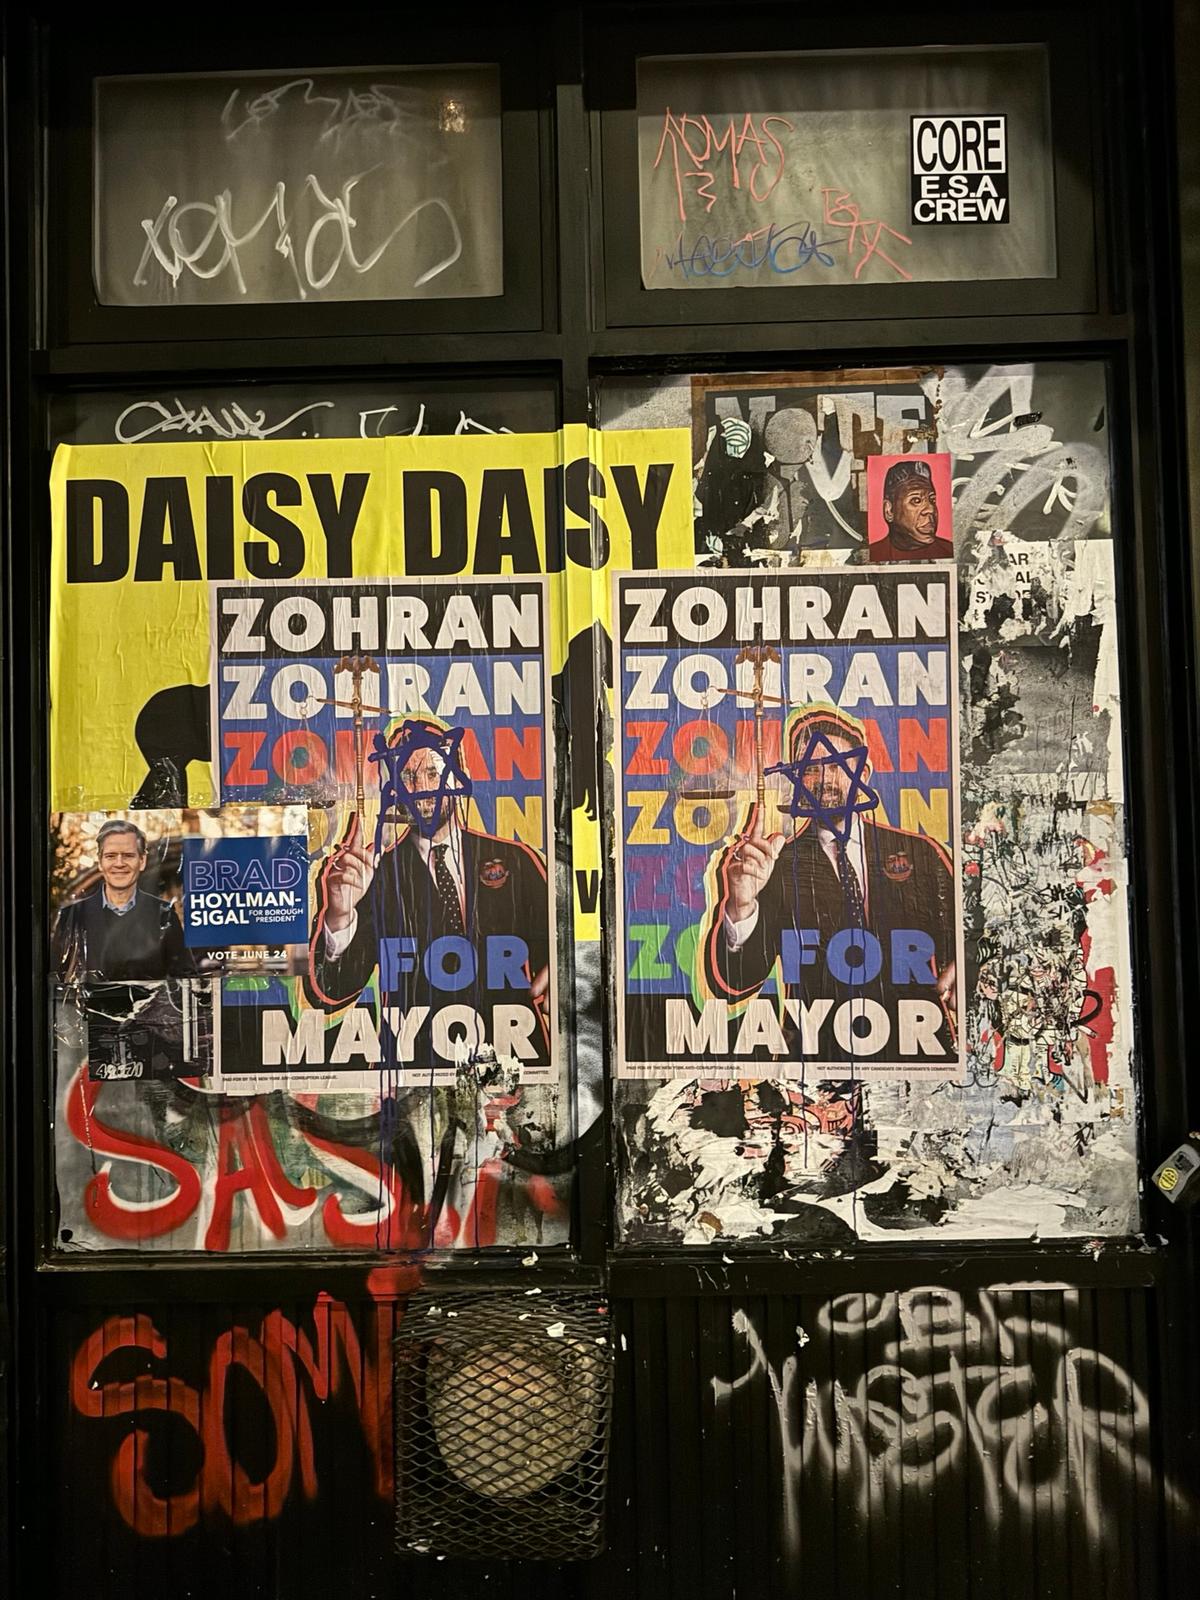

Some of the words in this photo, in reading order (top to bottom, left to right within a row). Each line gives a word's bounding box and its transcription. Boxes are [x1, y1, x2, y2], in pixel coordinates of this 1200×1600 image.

[917, 120, 1002, 172] CORE
[914, 198, 1006, 222] CREW
[921, 175, 999, 198] E.S.A
[66, 471, 371, 583] DAISY
[403, 457, 675, 576] DAISY
[222, 594, 540, 652] ZOHRAN
[624, 583, 947, 643] ZOHRAN
[189, 858, 302, 892] BRAD
[190, 891, 302, 909] HOYLMAN-
[190, 909, 250, 926] SIGAL
[255, 915, 296, 923] PRESIDENT
[207, 951, 238, 960] VOTE
[239, 950, 270, 959] JUNE
[273, 950, 288, 959] 24
[379, 935, 533, 992] FOR
[781, 928, 938, 986] FOR
[261, 1004, 539, 1066] MAYOR
[665, 998, 947, 1056] MAYOR
